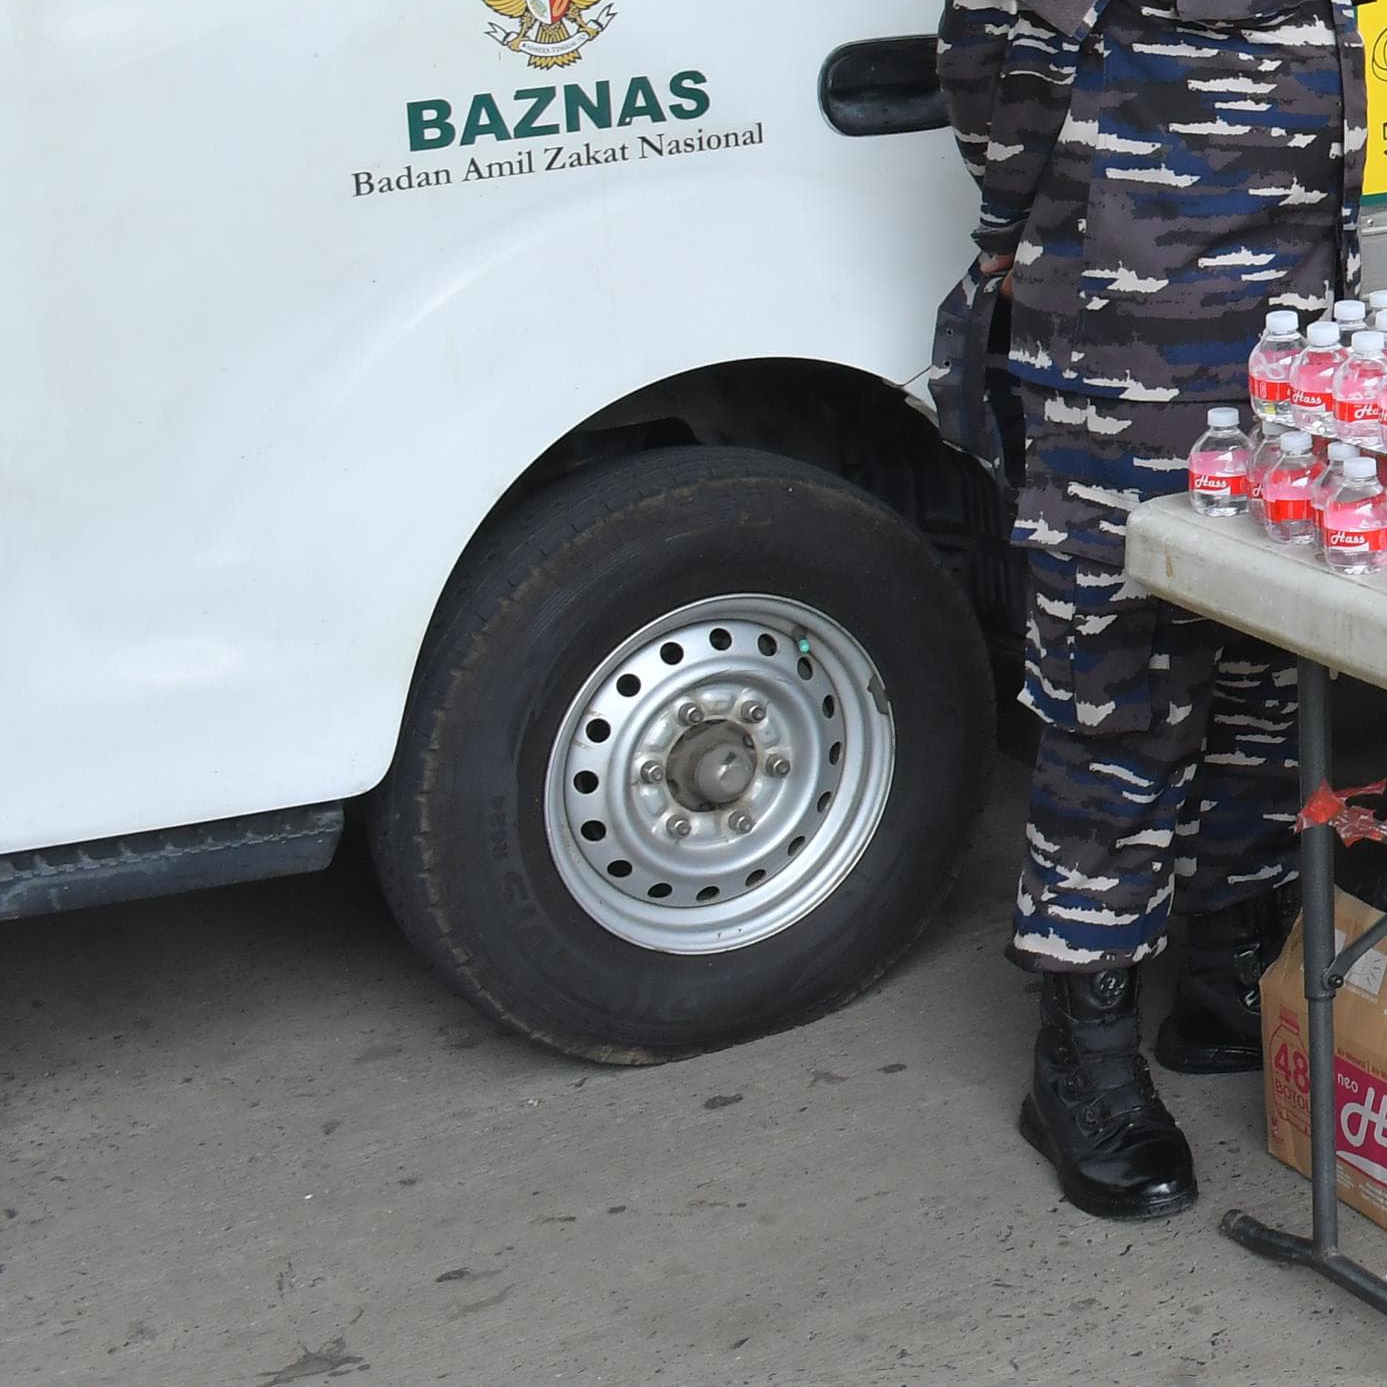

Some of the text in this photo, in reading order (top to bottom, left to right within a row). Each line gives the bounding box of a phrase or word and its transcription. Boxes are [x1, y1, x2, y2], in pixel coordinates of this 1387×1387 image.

[405, 68, 712, 154] BAZNAS
[350, 121, 766, 199] Badan Amil Zakat Nasional
[1194, 474, 1227, 490] Hass
[1330, 530, 1366, 546] Hass
[1274, 1042, 1310, 1096] 48
[1336, 1072, 1359, 1094] neo
